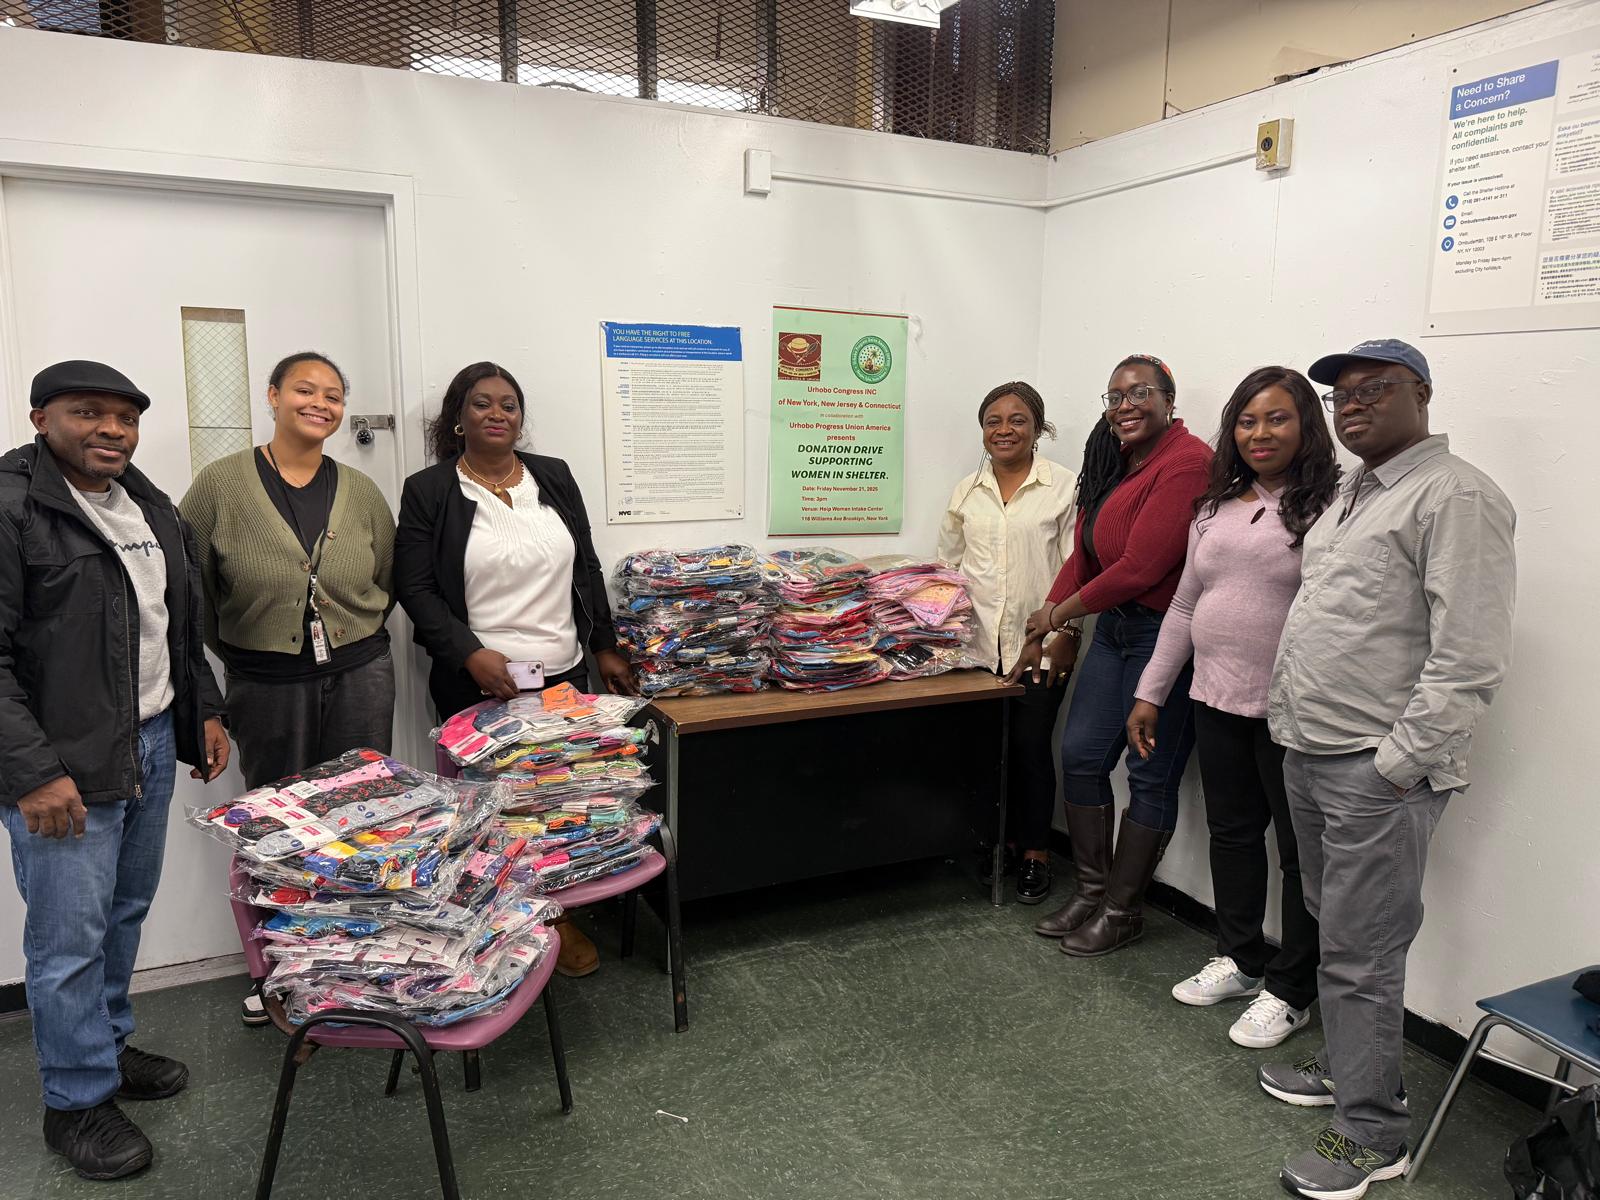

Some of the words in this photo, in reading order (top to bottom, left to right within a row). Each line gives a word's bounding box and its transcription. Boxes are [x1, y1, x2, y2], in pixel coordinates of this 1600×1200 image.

[1457, 84, 1482, 98] Need
[1484, 81, 1494, 92] to
[1496, 72, 1526, 89] Share
[1456, 103, 1461, 111] a
[1464, 90, 1511, 109] Concern?
[1454, 119, 1476, 129] We're
[1477, 114, 1495, 125] here
[1497, 112, 1505, 122] to
[1508, 108, 1527, 118] help.
[1452, 128, 1462, 140] All
[1464, 122, 1508, 138] complaints
[1510, 120, 1523, 128] are
[1451, 134, 1499, 150] confidential.
[1454, 157, 1464, 165] you
[1465, 154, 1479, 162] need
[1480, 149, 1511, 159] assistance,
[1512, 144, 1533, 152] contact
[1535, 141, 1549, 150] your
[1449, 165, 1466, 174] shelter
[808, 386, 832, 394] Urhobo
[833, 387, 863, 396] Congress
[803, 399, 819, 407] York,
[836, 401, 858, 409] Jersey
[864, 402, 901, 410] Connecticut
[815, 423, 844, 431] Progress
[798, 444, 851, 454] DONATION
[853, 446, 884, 454] DRIVE
[808, 457, 873, 466] SUPPORTING
[791, 470, 831, 479] WOMEN
[833, 471, 843, 479] IN
[845, 471, 889, 480] SHELTER.
